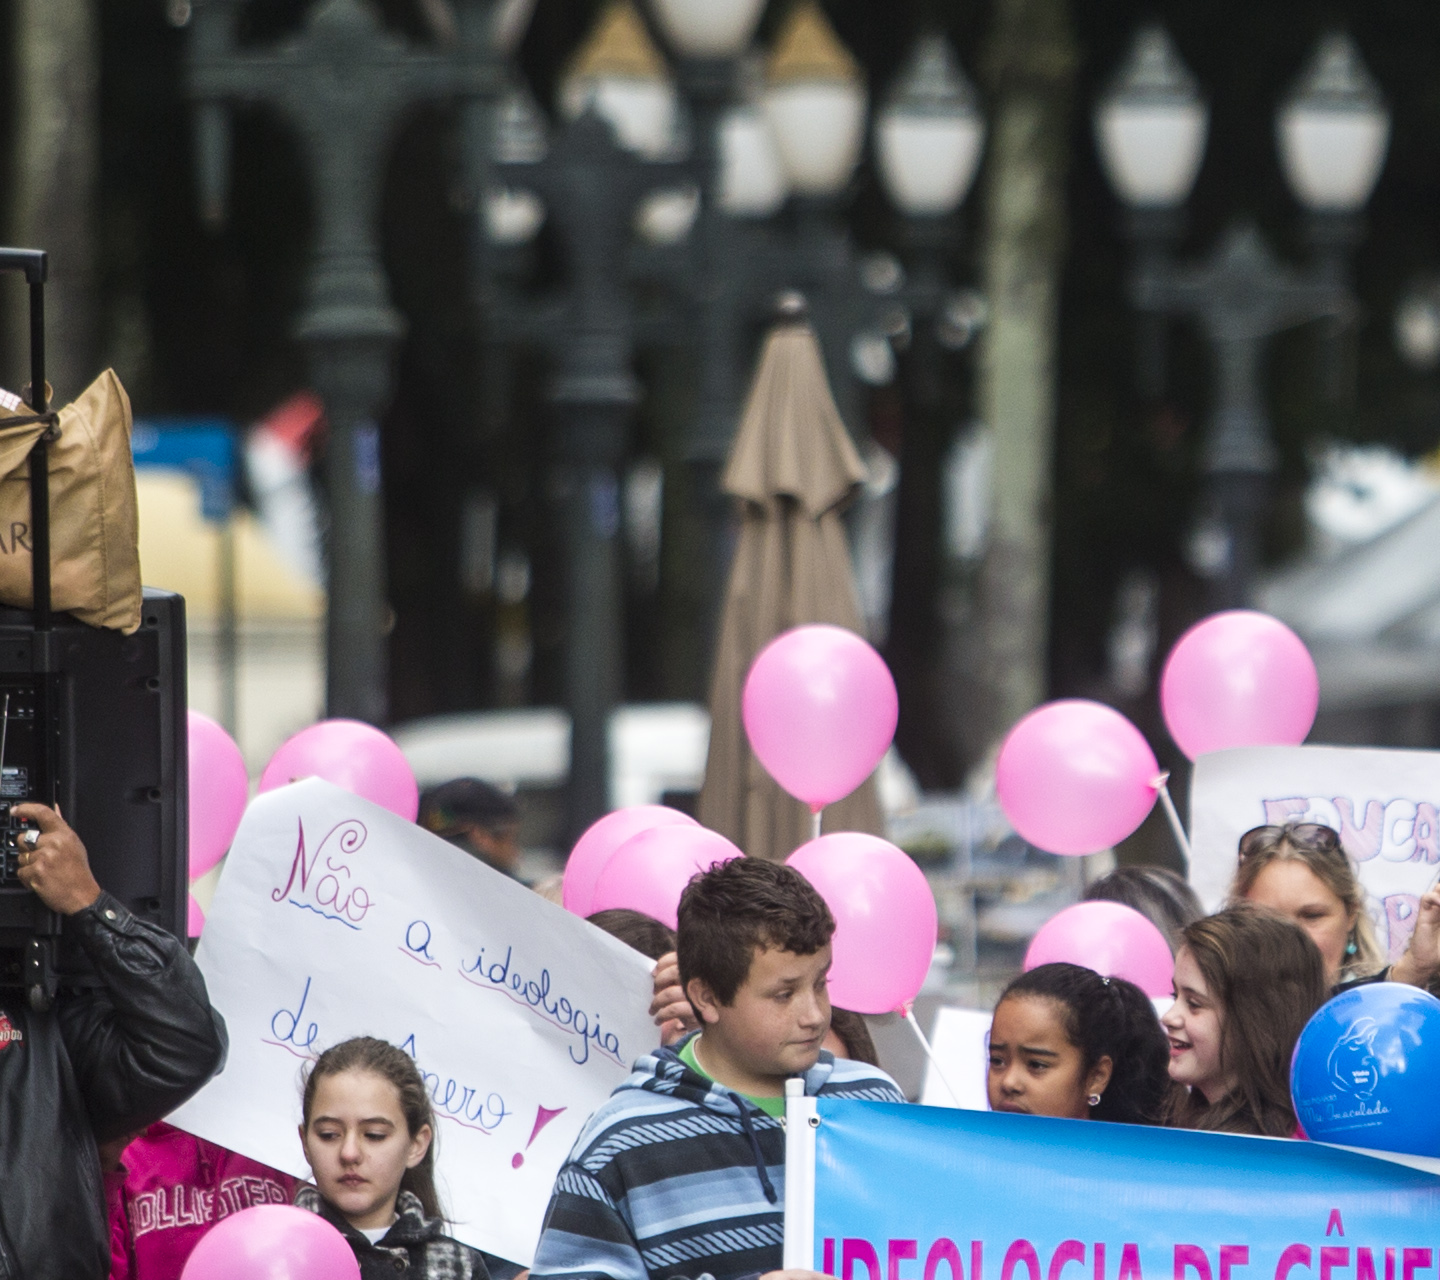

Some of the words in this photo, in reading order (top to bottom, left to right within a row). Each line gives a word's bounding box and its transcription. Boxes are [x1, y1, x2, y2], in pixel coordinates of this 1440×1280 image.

[271, 815, 375, 923] Não
[270, 976, 320, 1048] de
[405, 920, 435, 961] a
[460, 946, 624, 1065] ideologia
